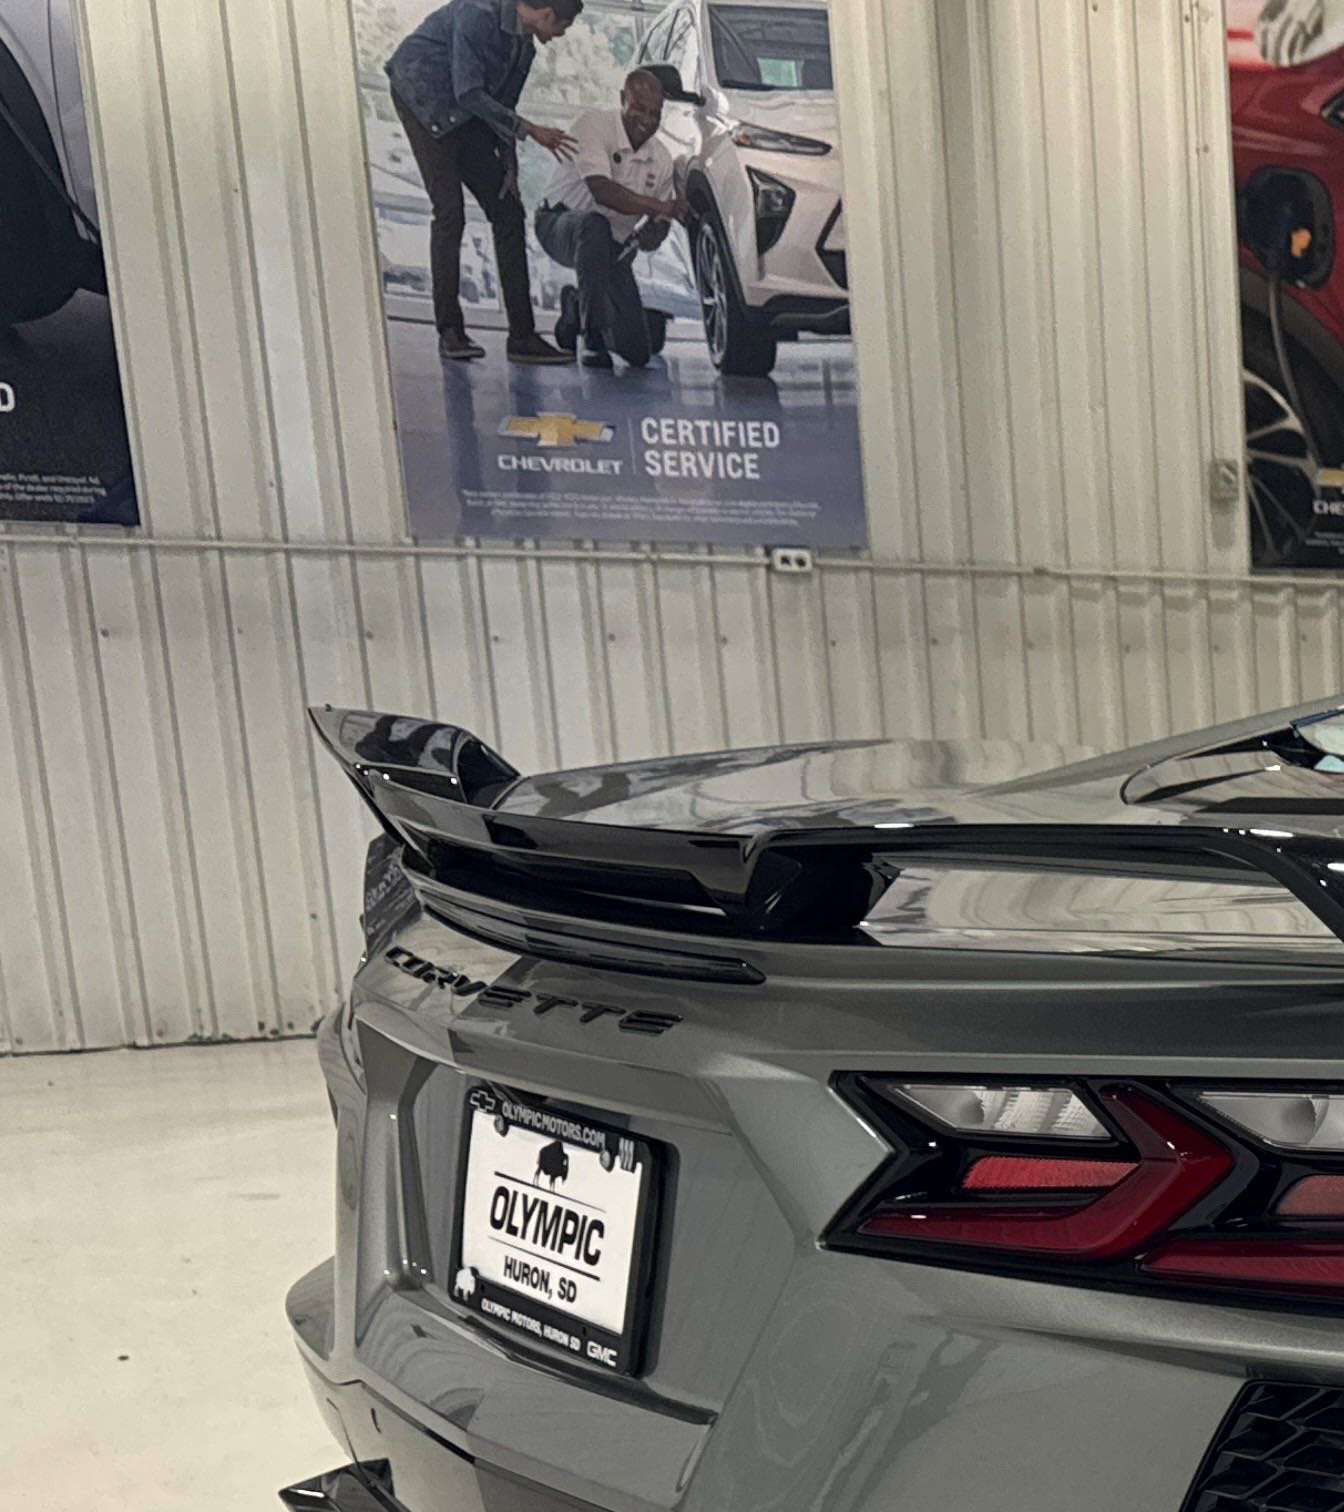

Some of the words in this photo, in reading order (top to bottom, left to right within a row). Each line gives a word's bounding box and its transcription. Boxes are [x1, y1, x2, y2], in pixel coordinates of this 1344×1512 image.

[641, 417, 781, 449] CERTIFIED
[497, 454, 623, 475] CHEVROLET
[644, 451, 761, 480] SERVICE
[384, 946, 684, 1035] CORVETTE
[490, 1186, 604, 1266] OLYMPIC
[503, 1255, 553, 1300] HURON,
[557, 1276, 578, 1304] SD
[586, 1340, 619, 1367] GMC
